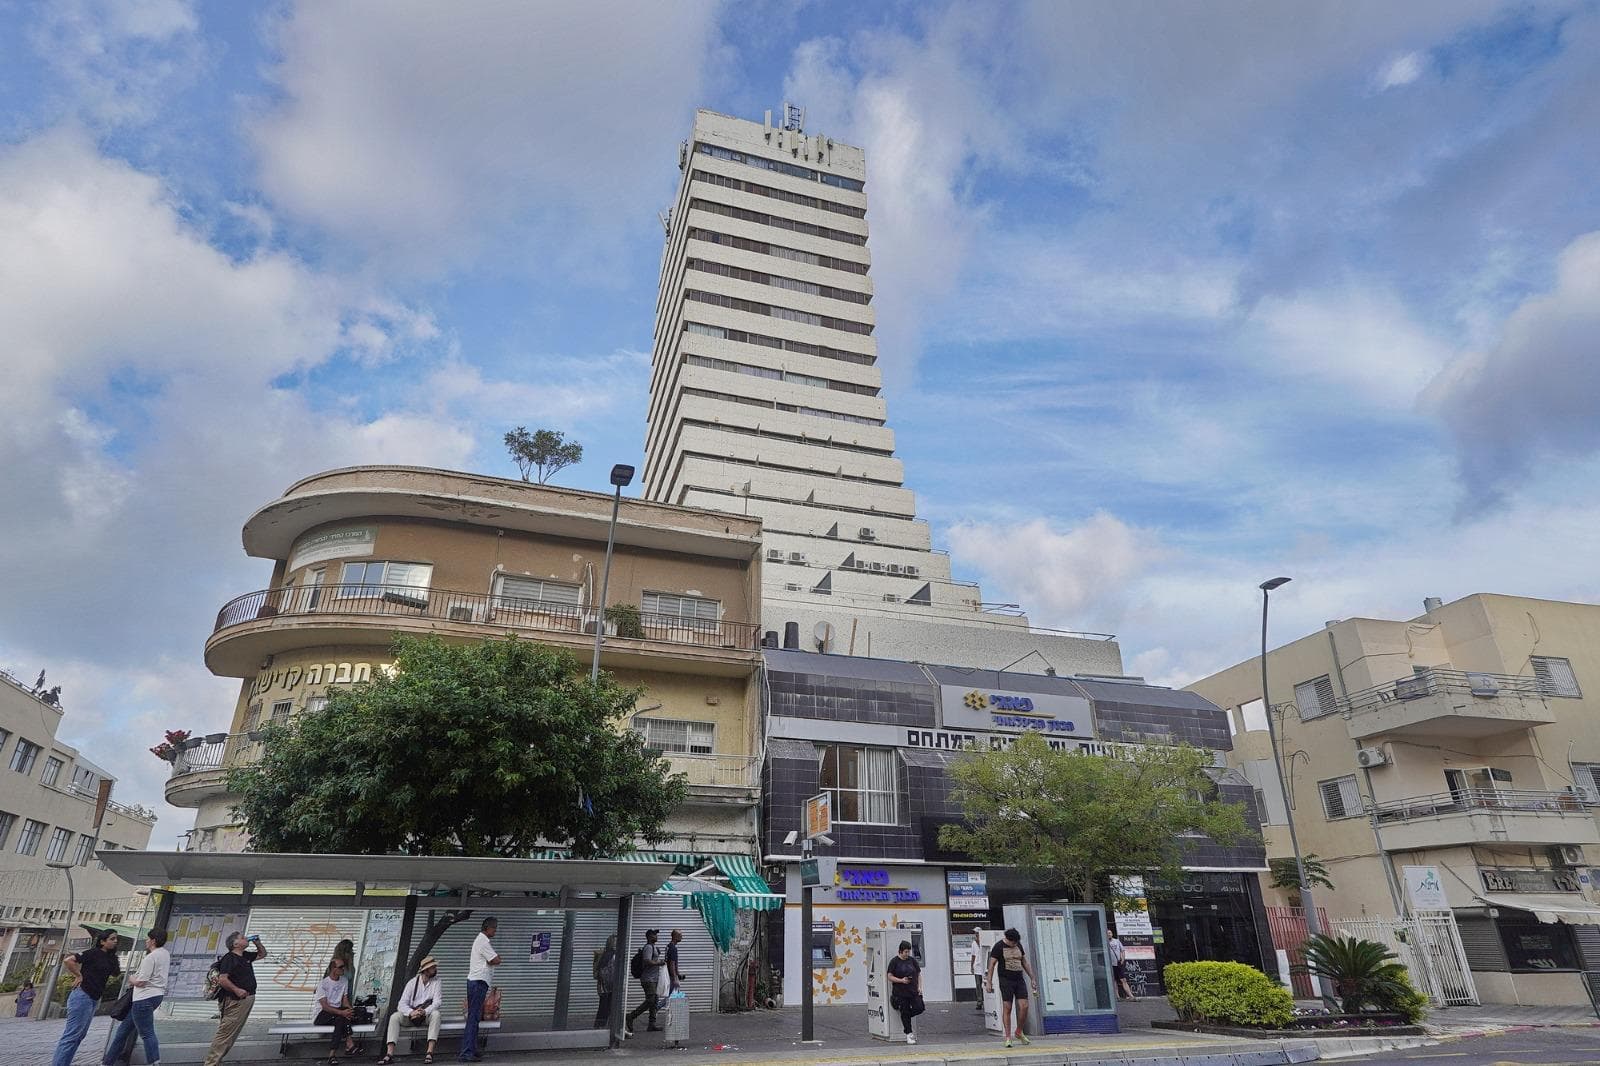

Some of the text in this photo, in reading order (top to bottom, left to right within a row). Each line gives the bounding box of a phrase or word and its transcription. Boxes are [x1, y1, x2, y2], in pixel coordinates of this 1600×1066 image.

[306, 662, 372, 685] חברה
[990, 694, 1034, 712] פאגי
[842, 869, 890, 887] פאגי
[893, 890, 920, 903] הבנק
